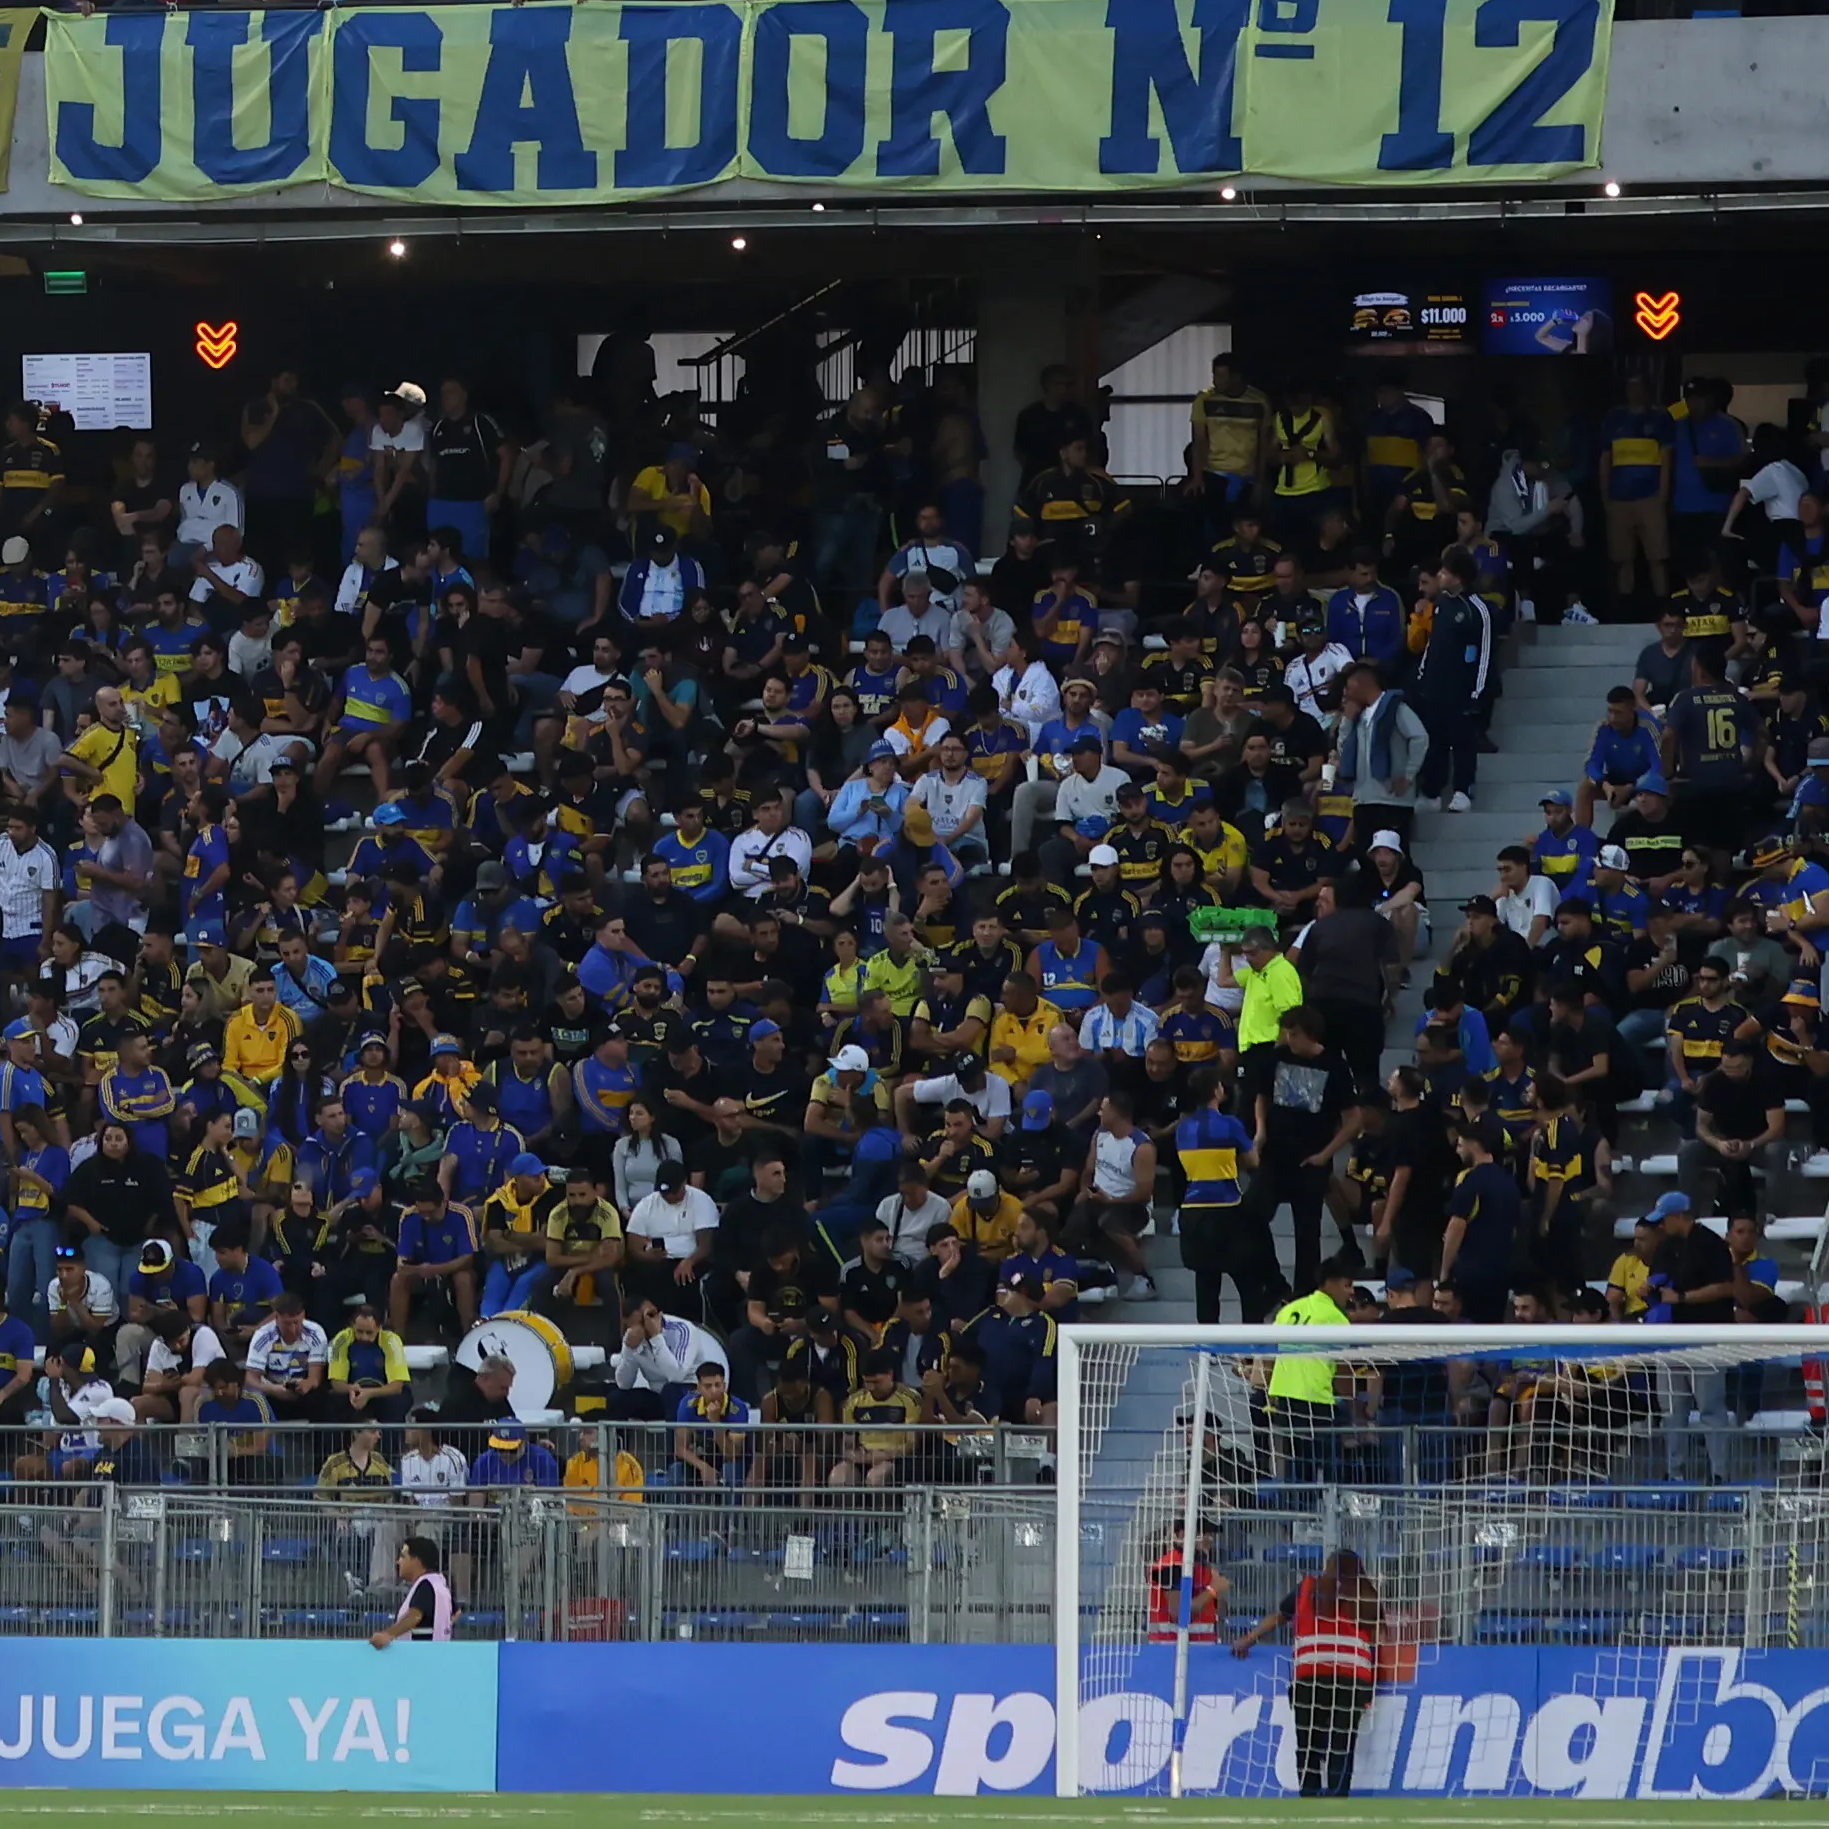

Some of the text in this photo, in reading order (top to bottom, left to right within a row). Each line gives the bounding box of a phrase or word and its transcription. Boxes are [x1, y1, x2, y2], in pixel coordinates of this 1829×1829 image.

[1420, 307, 1467, 325] $11.000
[1706, 708, 1738, 750] 16
[288, 1697, 412, 1764] YA!
